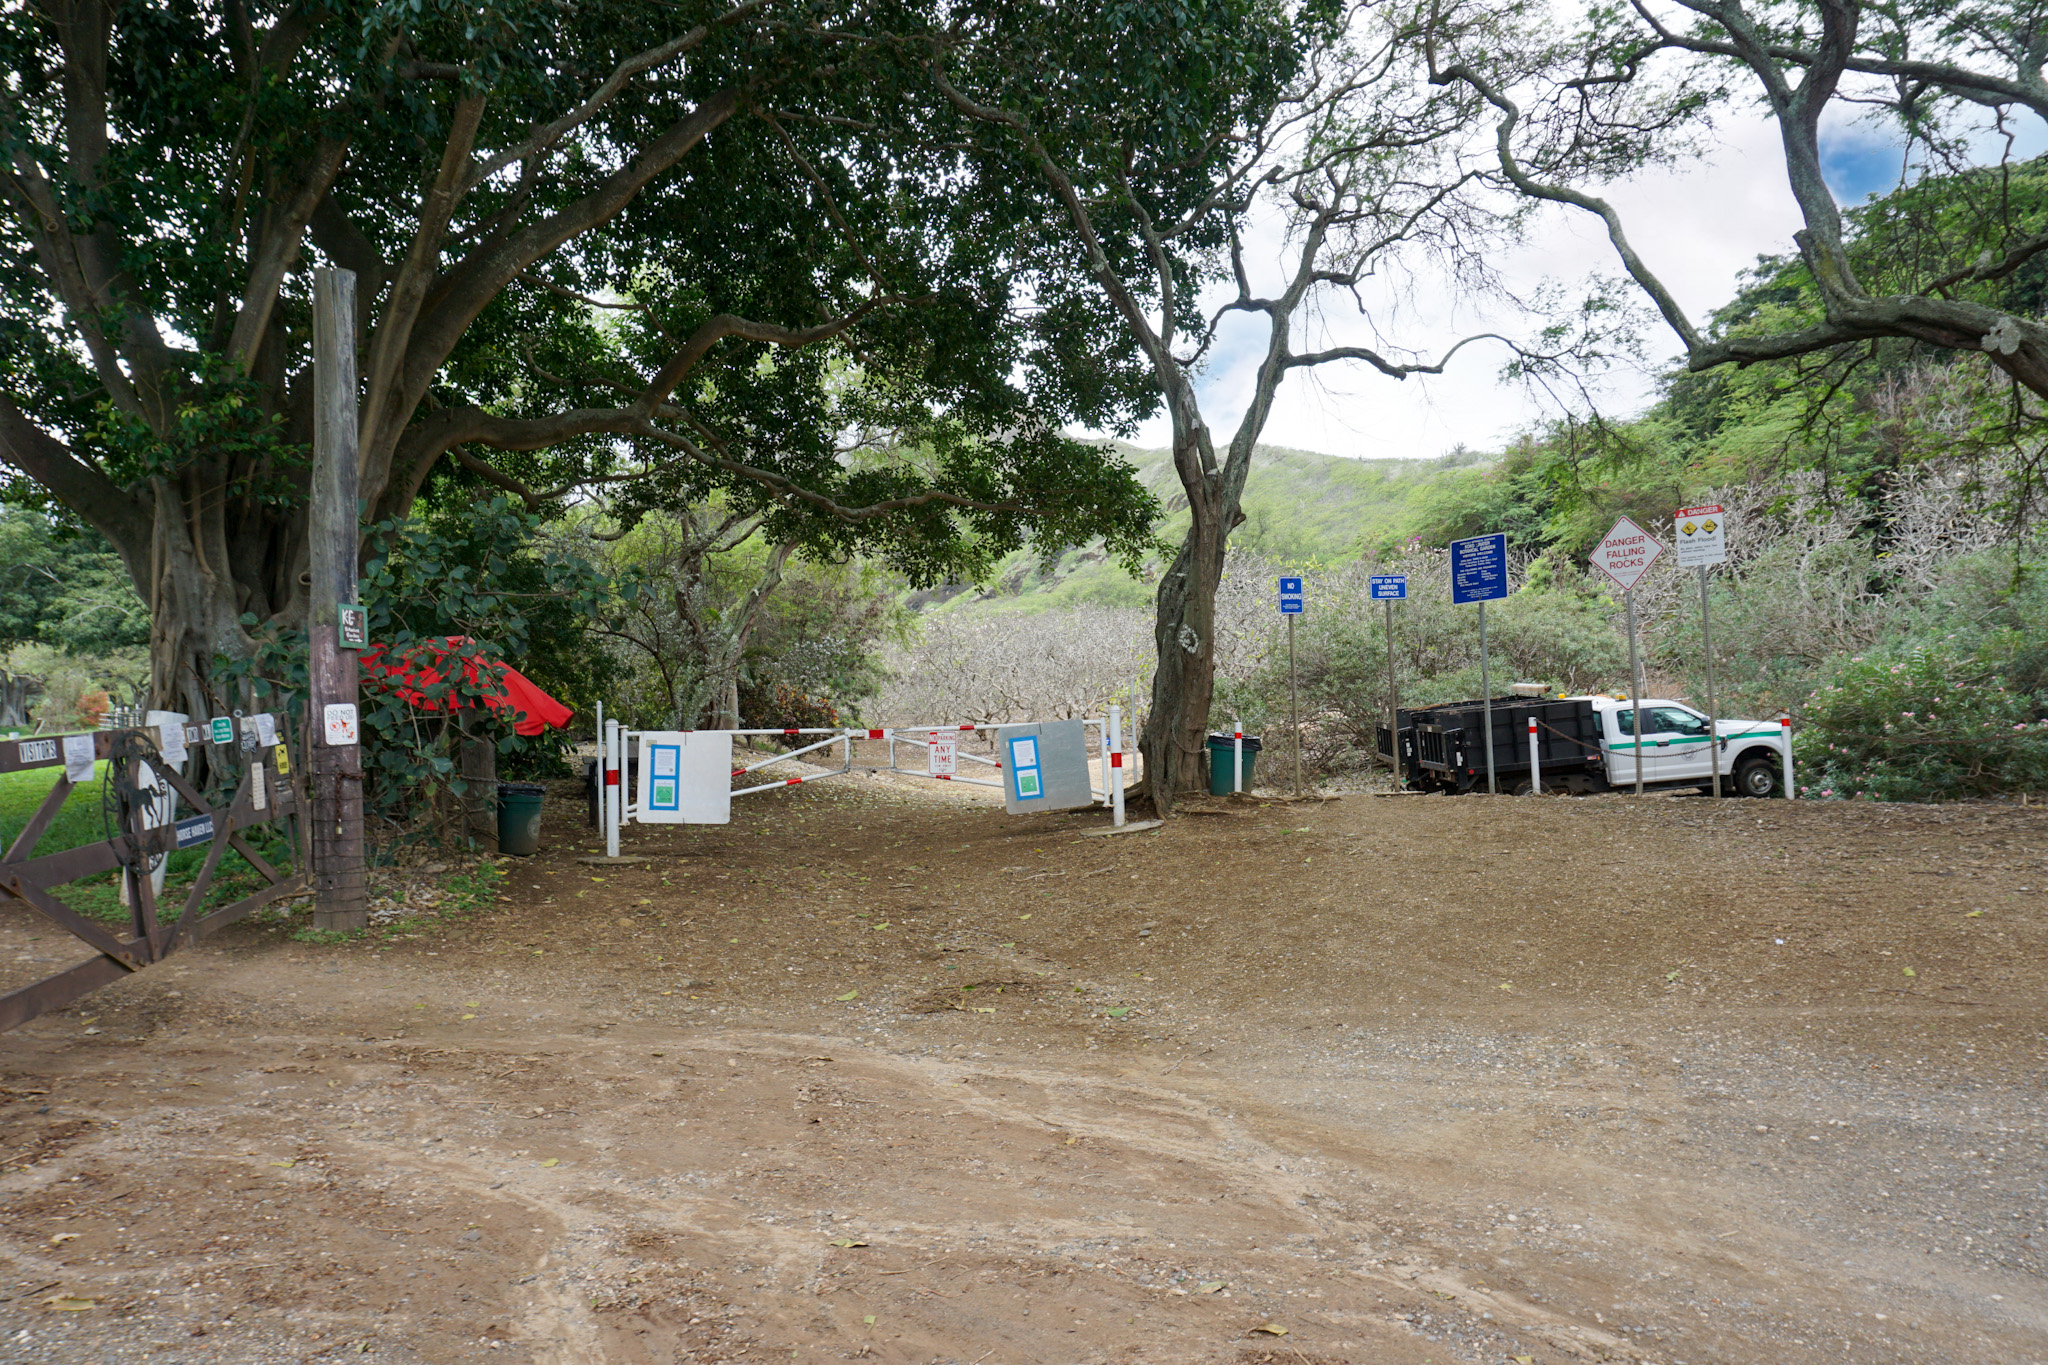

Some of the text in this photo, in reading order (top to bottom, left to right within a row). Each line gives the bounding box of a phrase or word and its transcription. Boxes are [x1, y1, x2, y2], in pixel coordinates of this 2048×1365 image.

[1688, 506, 1718, 516] DANGER
[1605, 536, 1645, 548] DANGER
[1606, 547, 1645, 559] FALLING
[1610, 558, 1644, 569] ROCKS
[19, 741, 56, 762] VISITORS
[934, 755, 951, 763] TIME
[177, 821, 214, 840] HORSE HAVEN LLC
